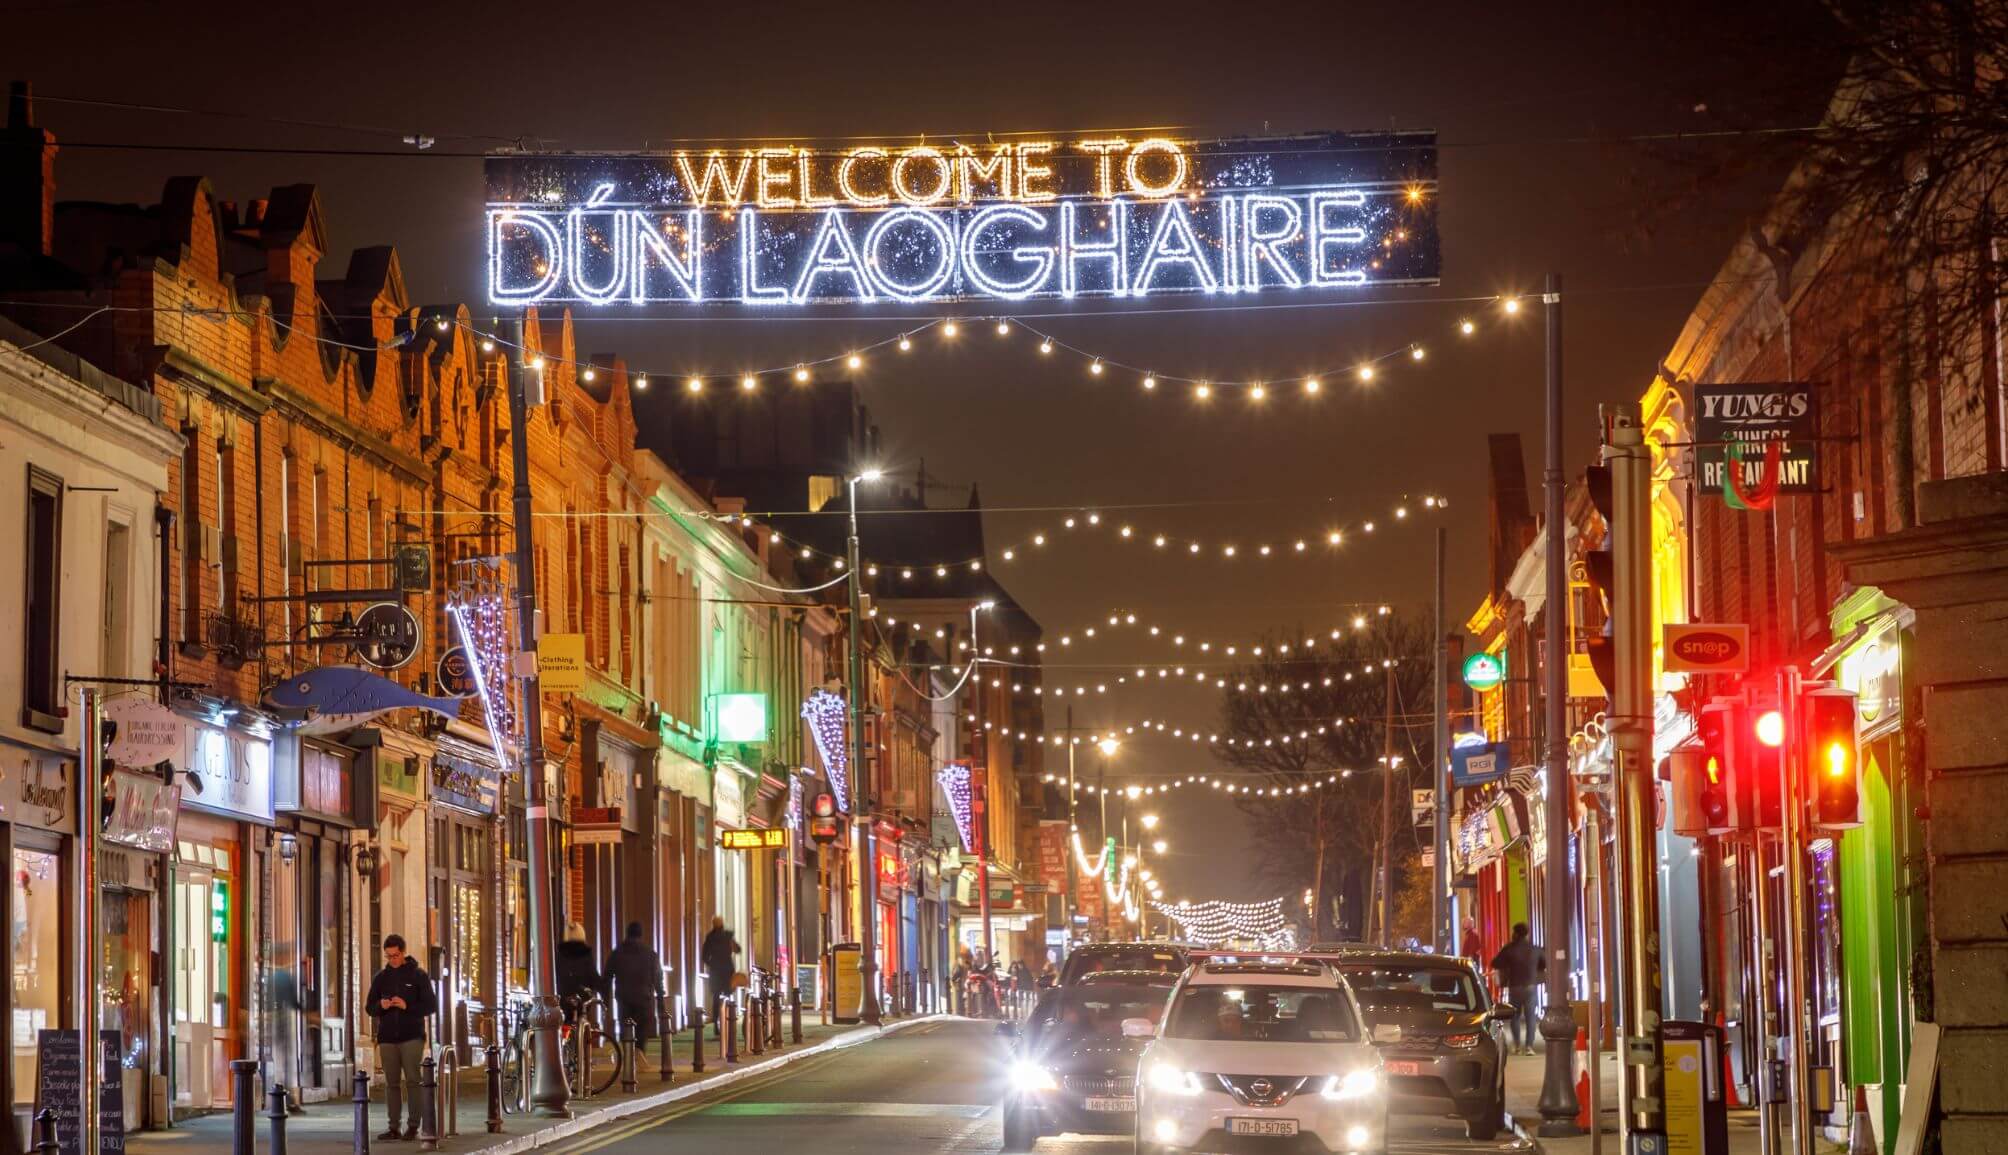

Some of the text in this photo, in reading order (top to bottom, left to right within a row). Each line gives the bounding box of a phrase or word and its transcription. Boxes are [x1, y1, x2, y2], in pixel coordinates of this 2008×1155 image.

[676, 138, 1188, 208] WELCOME TO
[487, 182, 1368, 305] DÚN LAOGHAIRE
[1702, 393, 1808, 418] YUNG'S
[1682, 640, 1730, 657] sn@p
